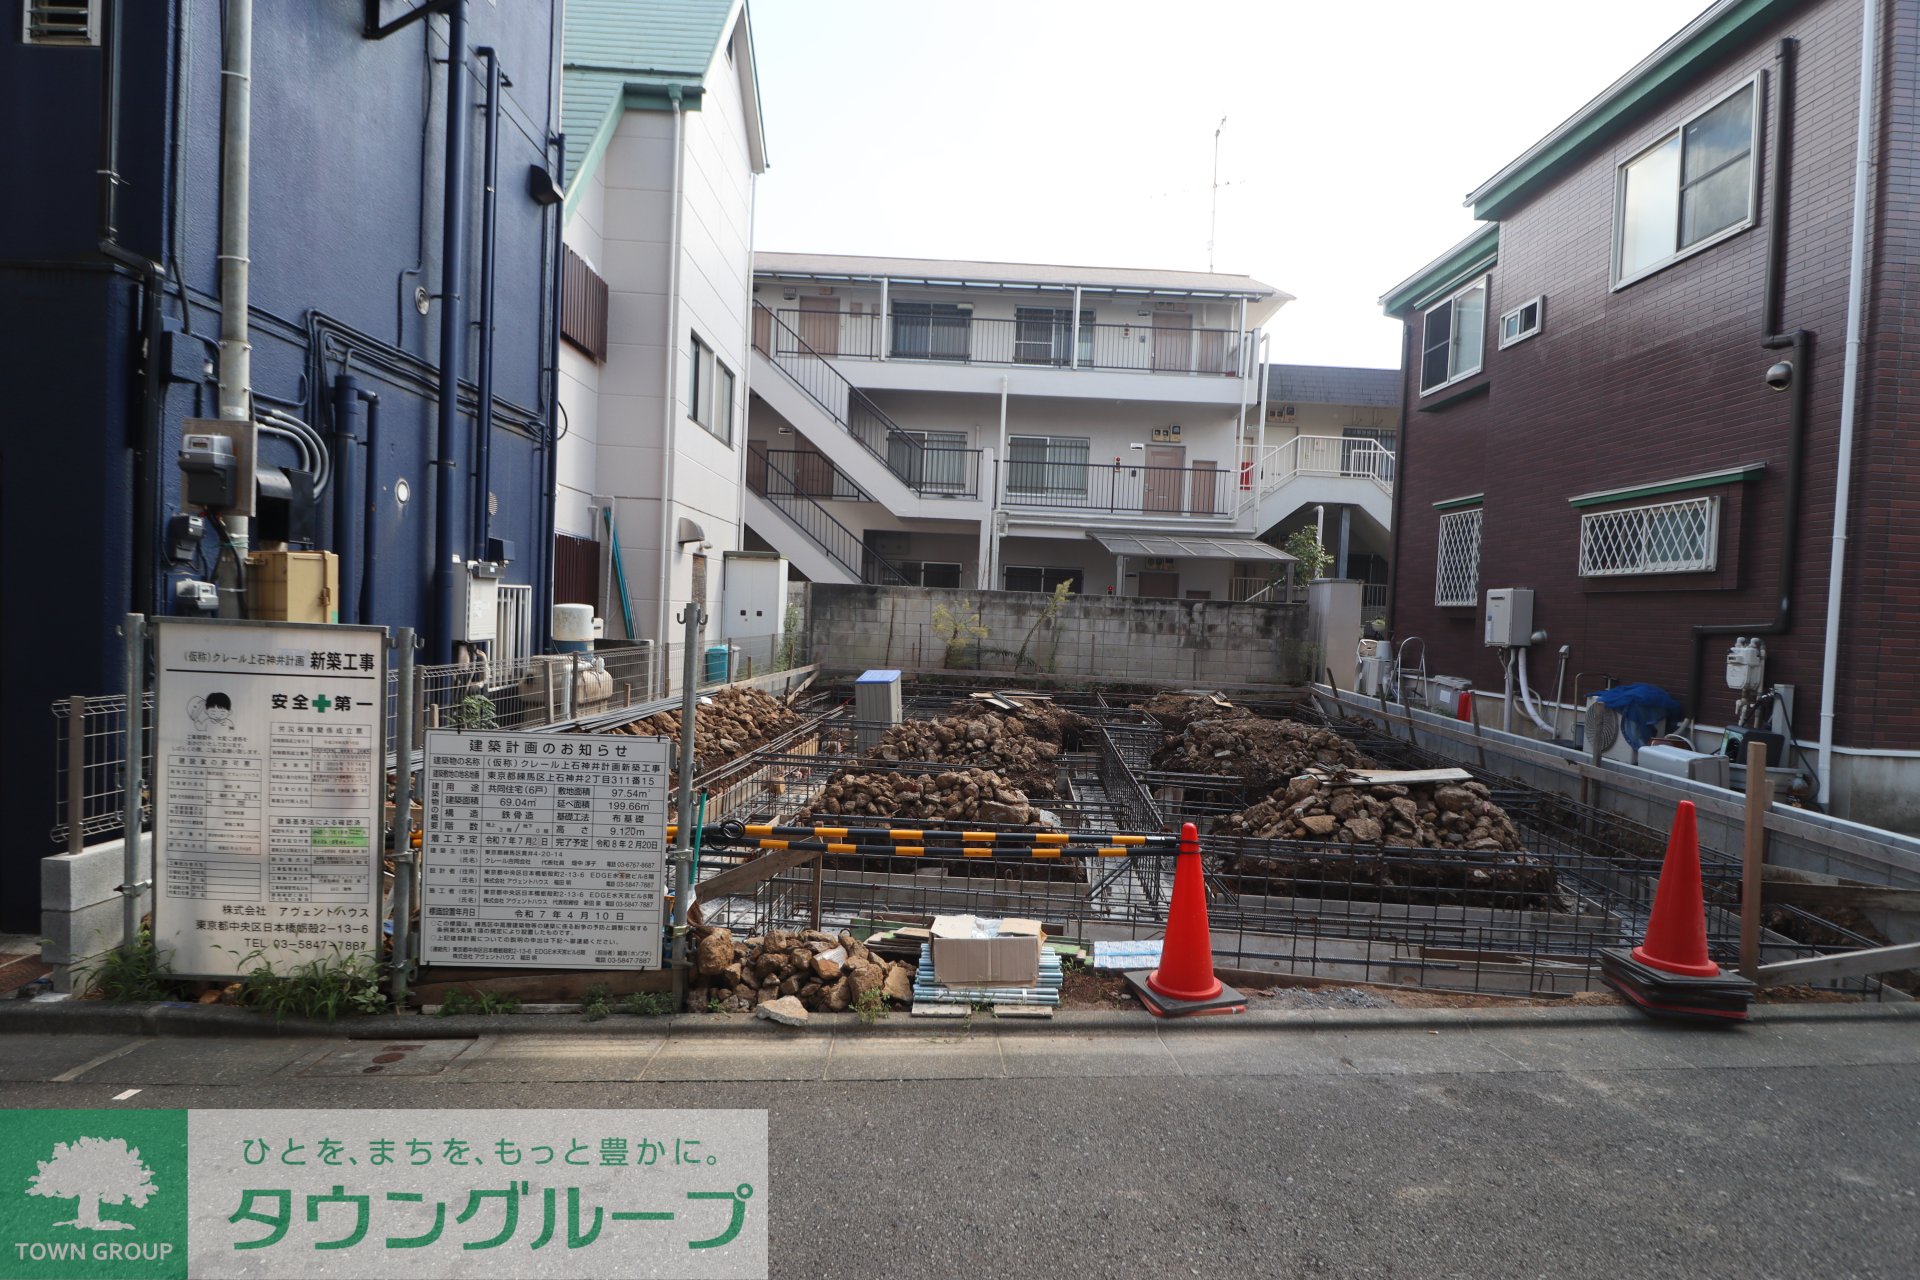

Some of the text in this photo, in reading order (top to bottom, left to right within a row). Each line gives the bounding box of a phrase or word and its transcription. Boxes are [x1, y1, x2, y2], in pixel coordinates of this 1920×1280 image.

[310, 651, 374, 671] 新築工事
[271, 694, 373, 711] 安全 第一
[470, 740, 627, 757] 建築計画のお知らせ
[434, 757, 480, 766] 建築物の名称
[488, 785, 547, 794] 共同住宅(6戸)
[558, 787, 590, 796] 敷地面積
[445, 796, 479, 805] 建築面積
[557, 800, 590, 808] 延べ面積
[502, 811, 533, 819] 鉄骨造
[613, 815, 644, 823] 布基礎
[610, 827, 644, 835] 9.120m
[431, 834, 478, 843] 着工予定
[556, 838, 588, 847] 完了予定
[596, 840, 658, 849] 令和8年2月20日
[222, 905, 266, 916] 株式会社
[514, 910, 624, 920] 令和7年4月10日
[245, 938, 267, 948] TEL
